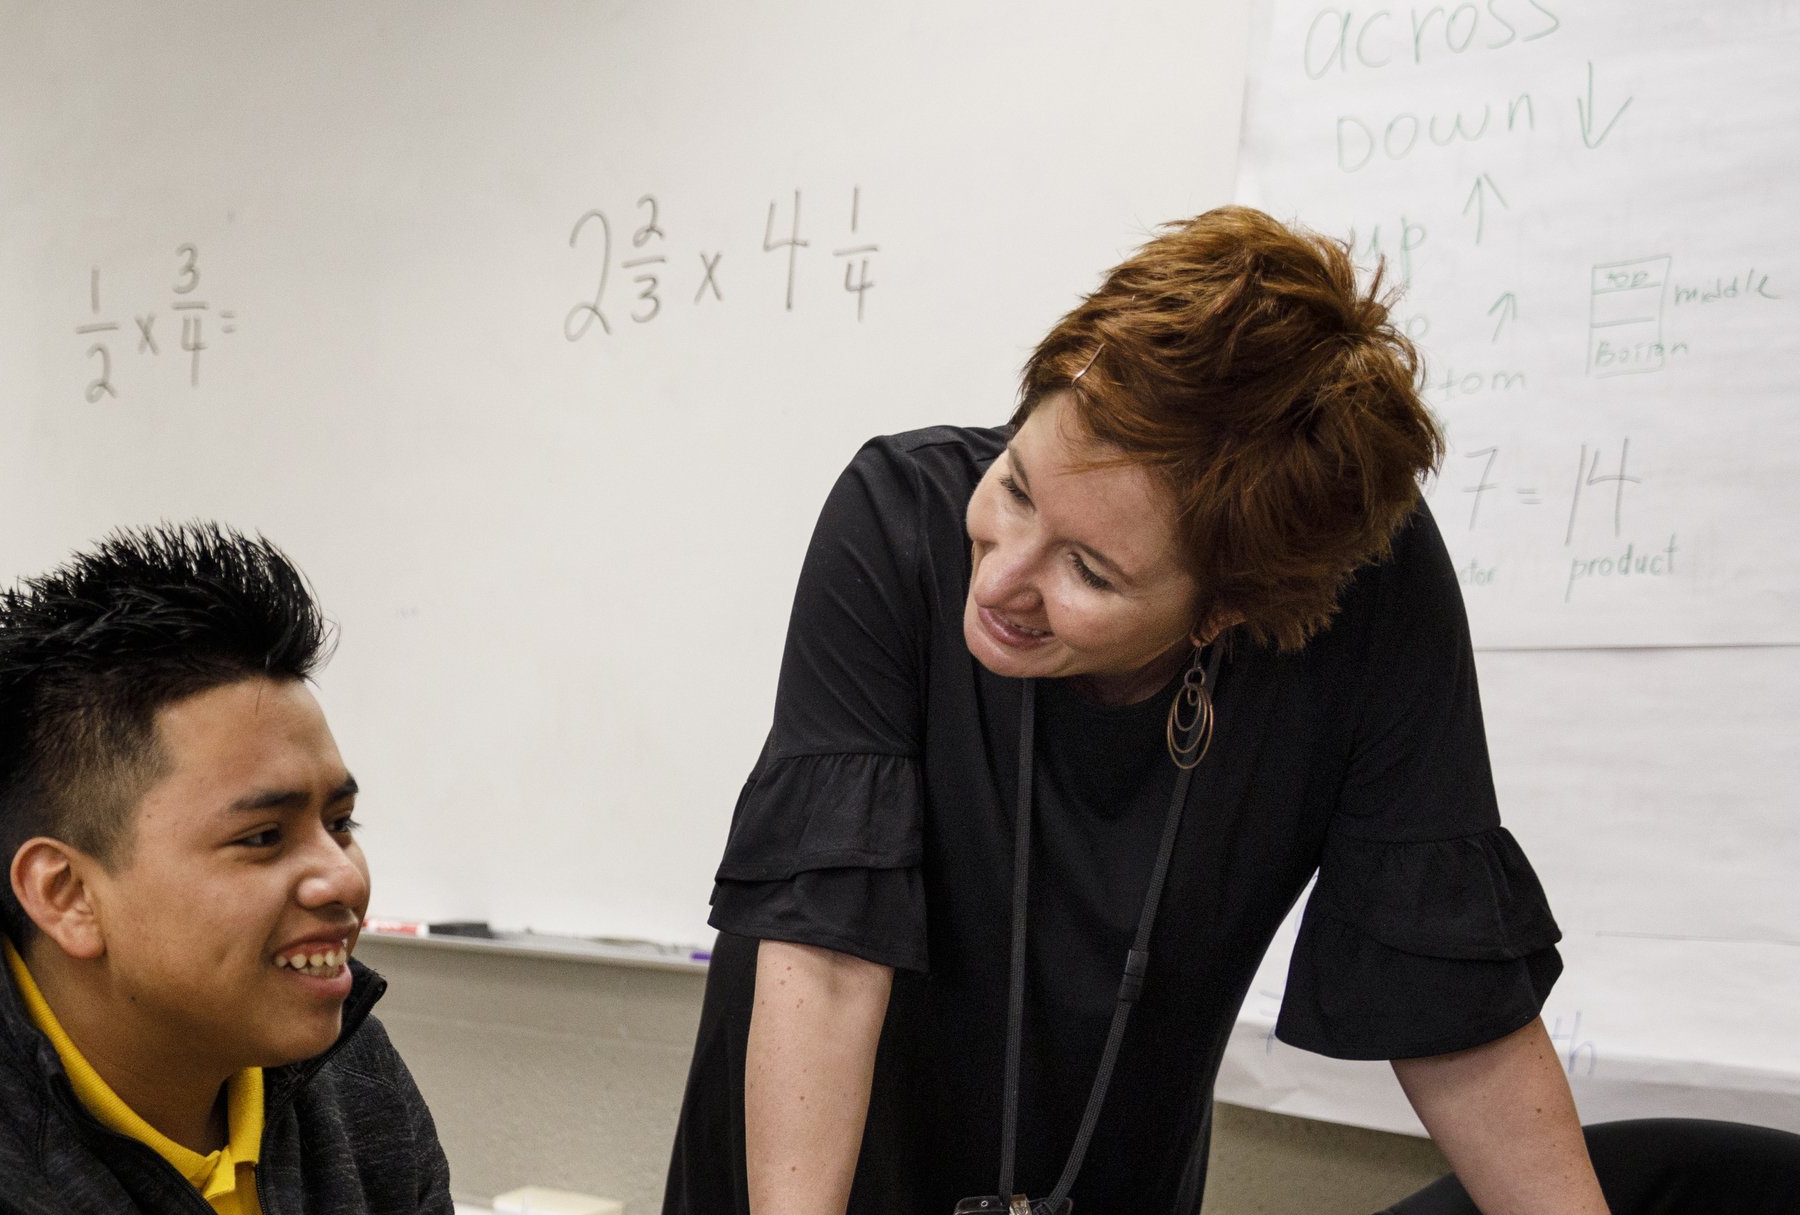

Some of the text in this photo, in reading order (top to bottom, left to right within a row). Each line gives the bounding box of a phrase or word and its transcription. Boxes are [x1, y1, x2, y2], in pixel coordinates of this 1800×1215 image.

[1424, 367, 1527, 401] tom
[1461, 445, 1500, 531] 7
[1563, 436, 1643, 546] 14
[1456, 532, 1681, 604] ctor product
